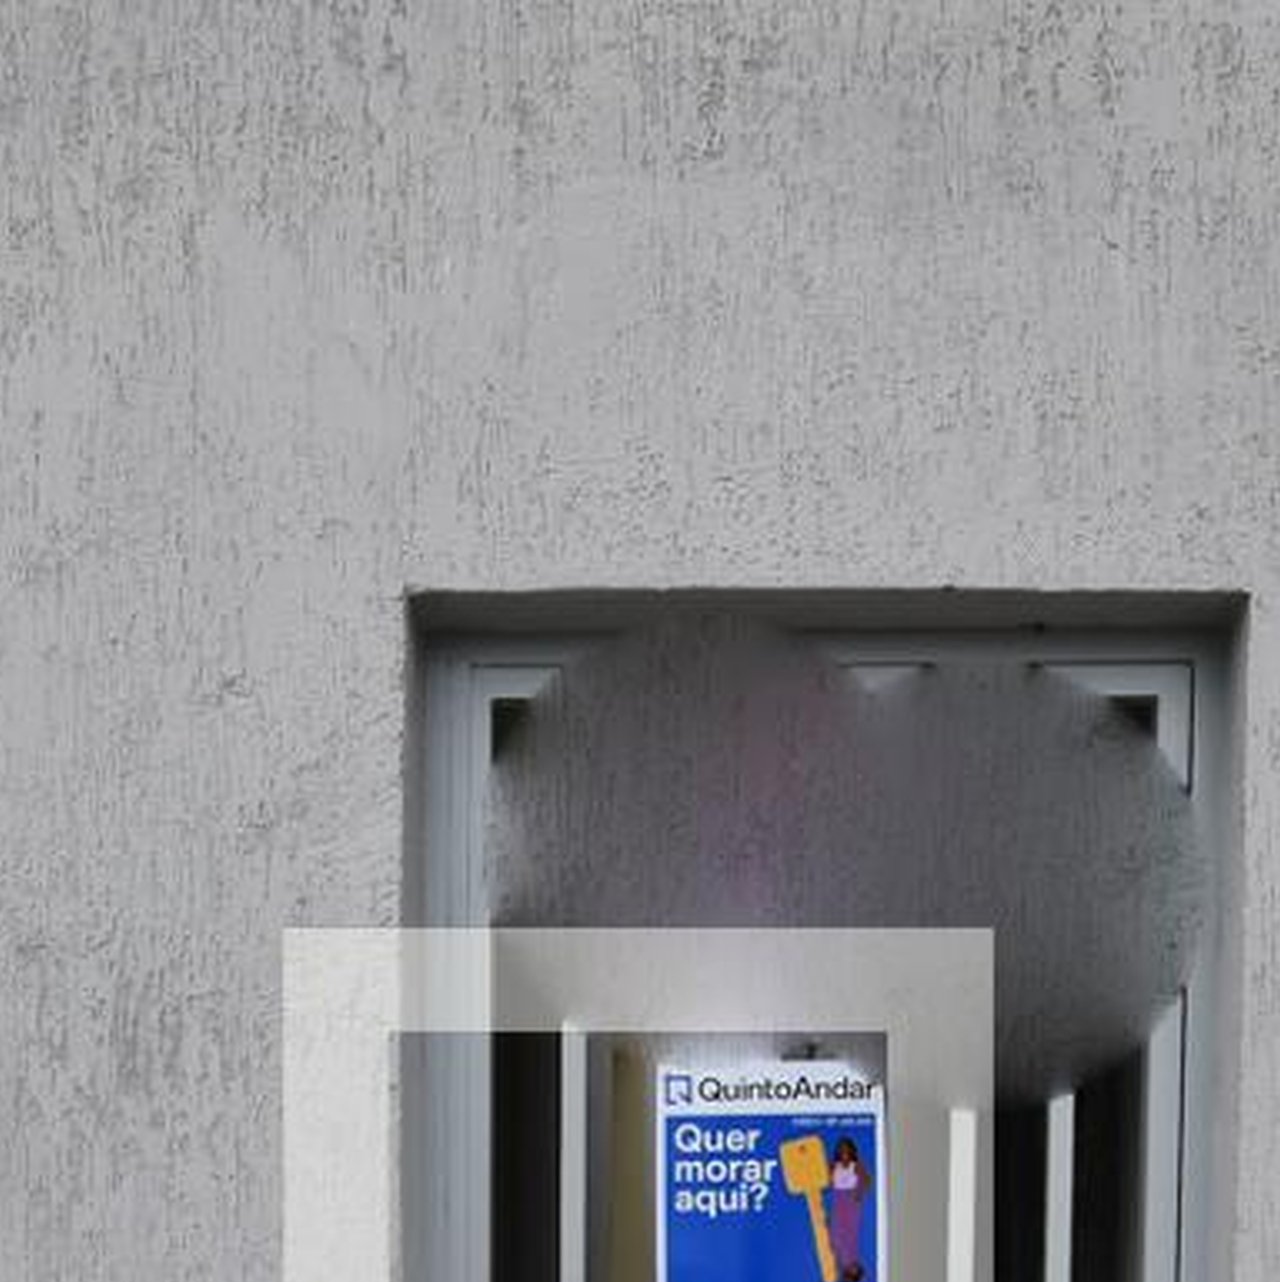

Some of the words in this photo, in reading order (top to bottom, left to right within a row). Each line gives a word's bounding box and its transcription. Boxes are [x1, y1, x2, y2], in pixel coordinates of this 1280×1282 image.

[698, 1076, 876, 1102] QuintoAndar
[675, 1123, 762, 1152] Quer
[675, 1160, 777, 1183] morar
[675, 1183, 769, 1218] aqui?
